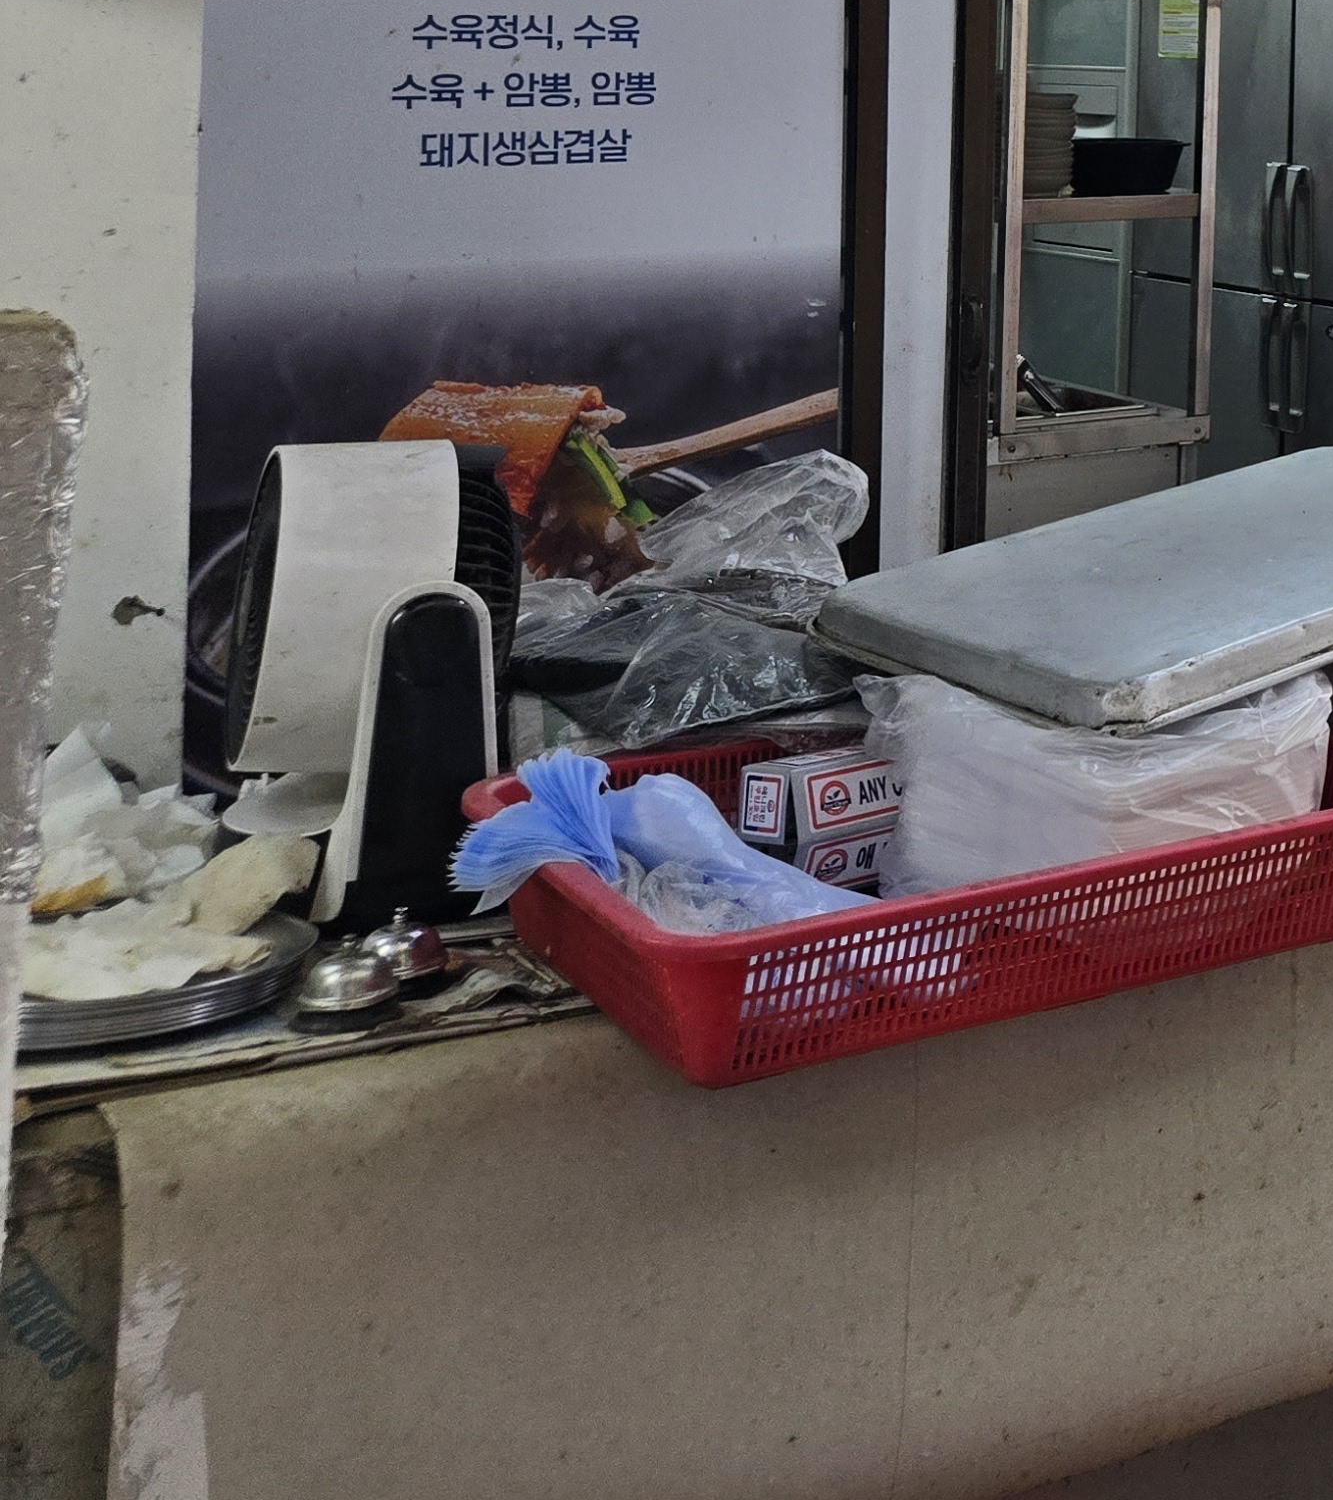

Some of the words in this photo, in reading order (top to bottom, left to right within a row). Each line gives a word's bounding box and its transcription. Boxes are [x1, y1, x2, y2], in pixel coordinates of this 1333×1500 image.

[412, 14, 564, 50] 수육정식,
[573, 14, 640, 49] 수육
[391, 73, 465, 109] 수육
[473, 82, 495, 103] +
[503, 72, 581, 109] 암뽕,
[591, 71, 657, 106] 암뽕
[419, 128, 632, 168] 돼지생삼겹살
[858, 775, 887, 805] ANY
